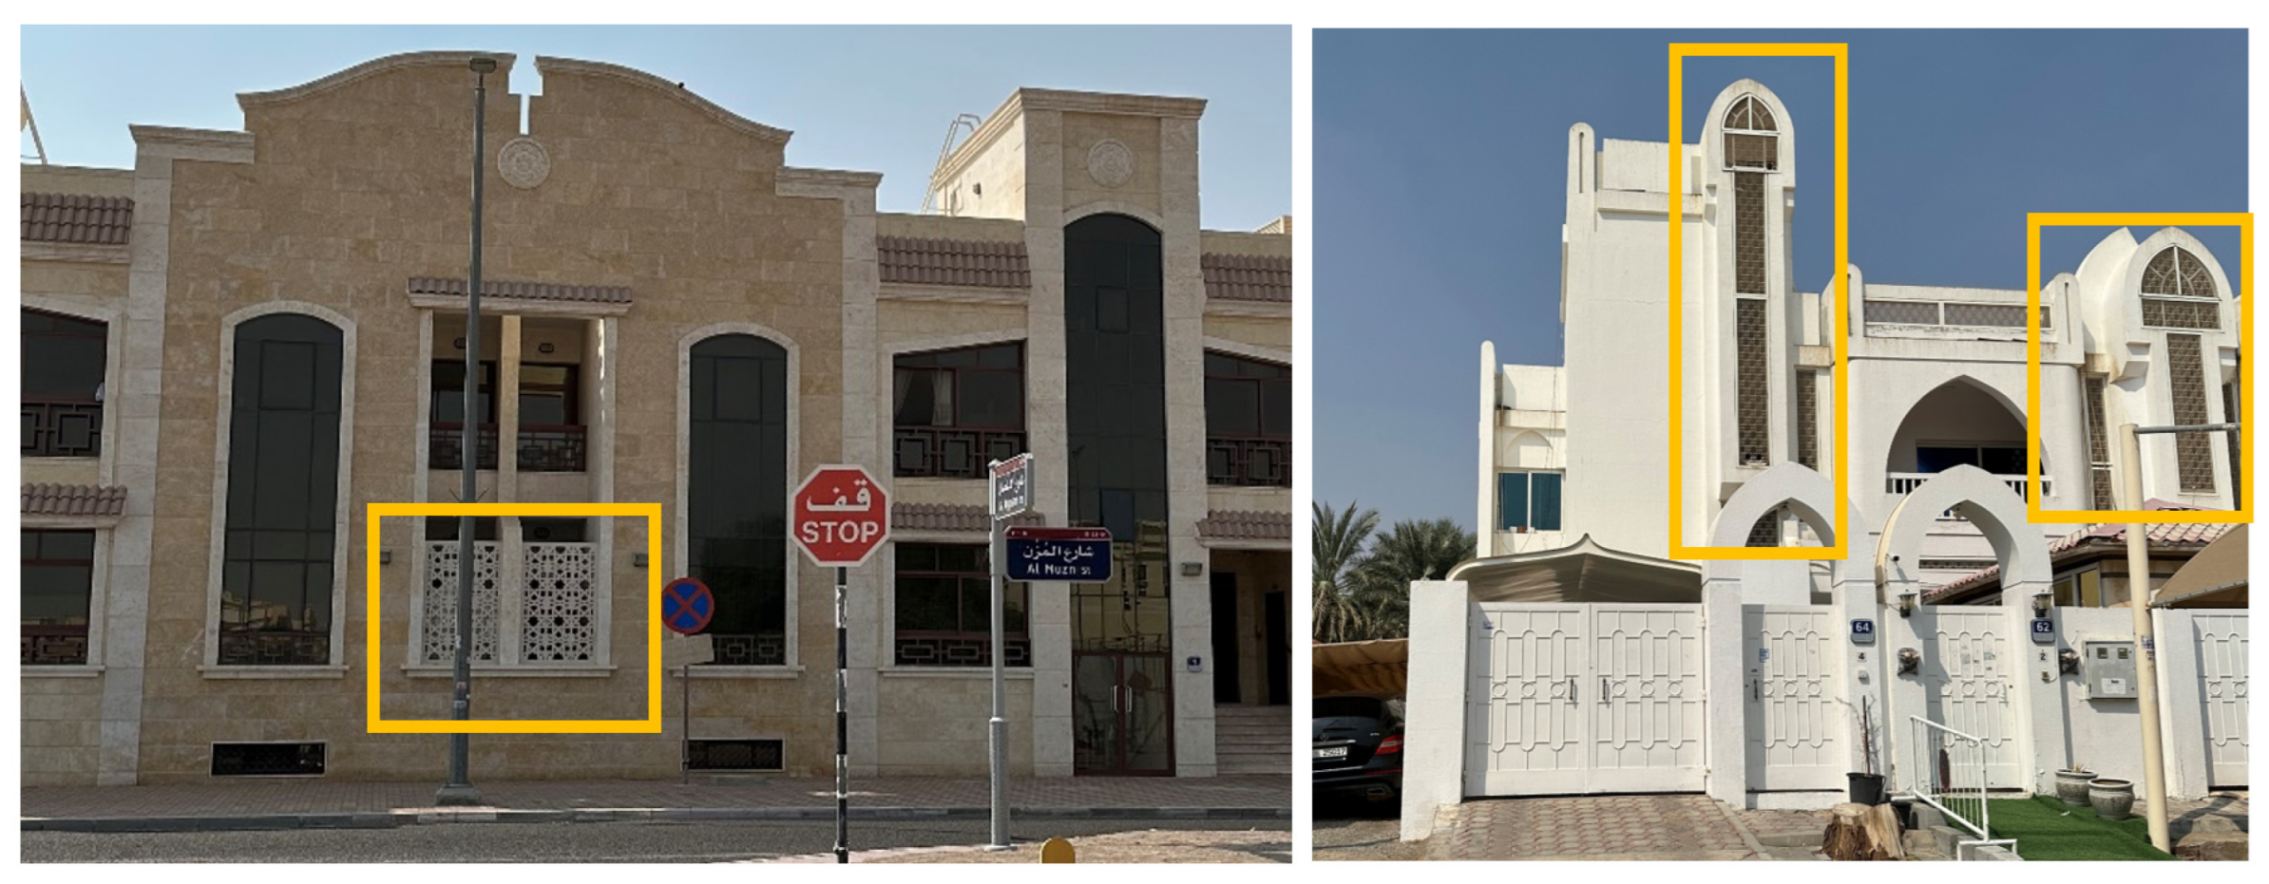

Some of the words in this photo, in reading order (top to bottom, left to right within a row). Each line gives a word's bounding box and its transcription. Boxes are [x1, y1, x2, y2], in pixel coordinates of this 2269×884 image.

[806, 478, 871, 512] قف
[802, 521, 879, 543] STOP
[1063, 545, 1094, 563] شارع
[1027, 562, 1040, 575] Al
[1045, 564, 1076, 575] Muzn
[1855, 621, 1869, 632] 64
[2036, 621, 2050, 632] 62
